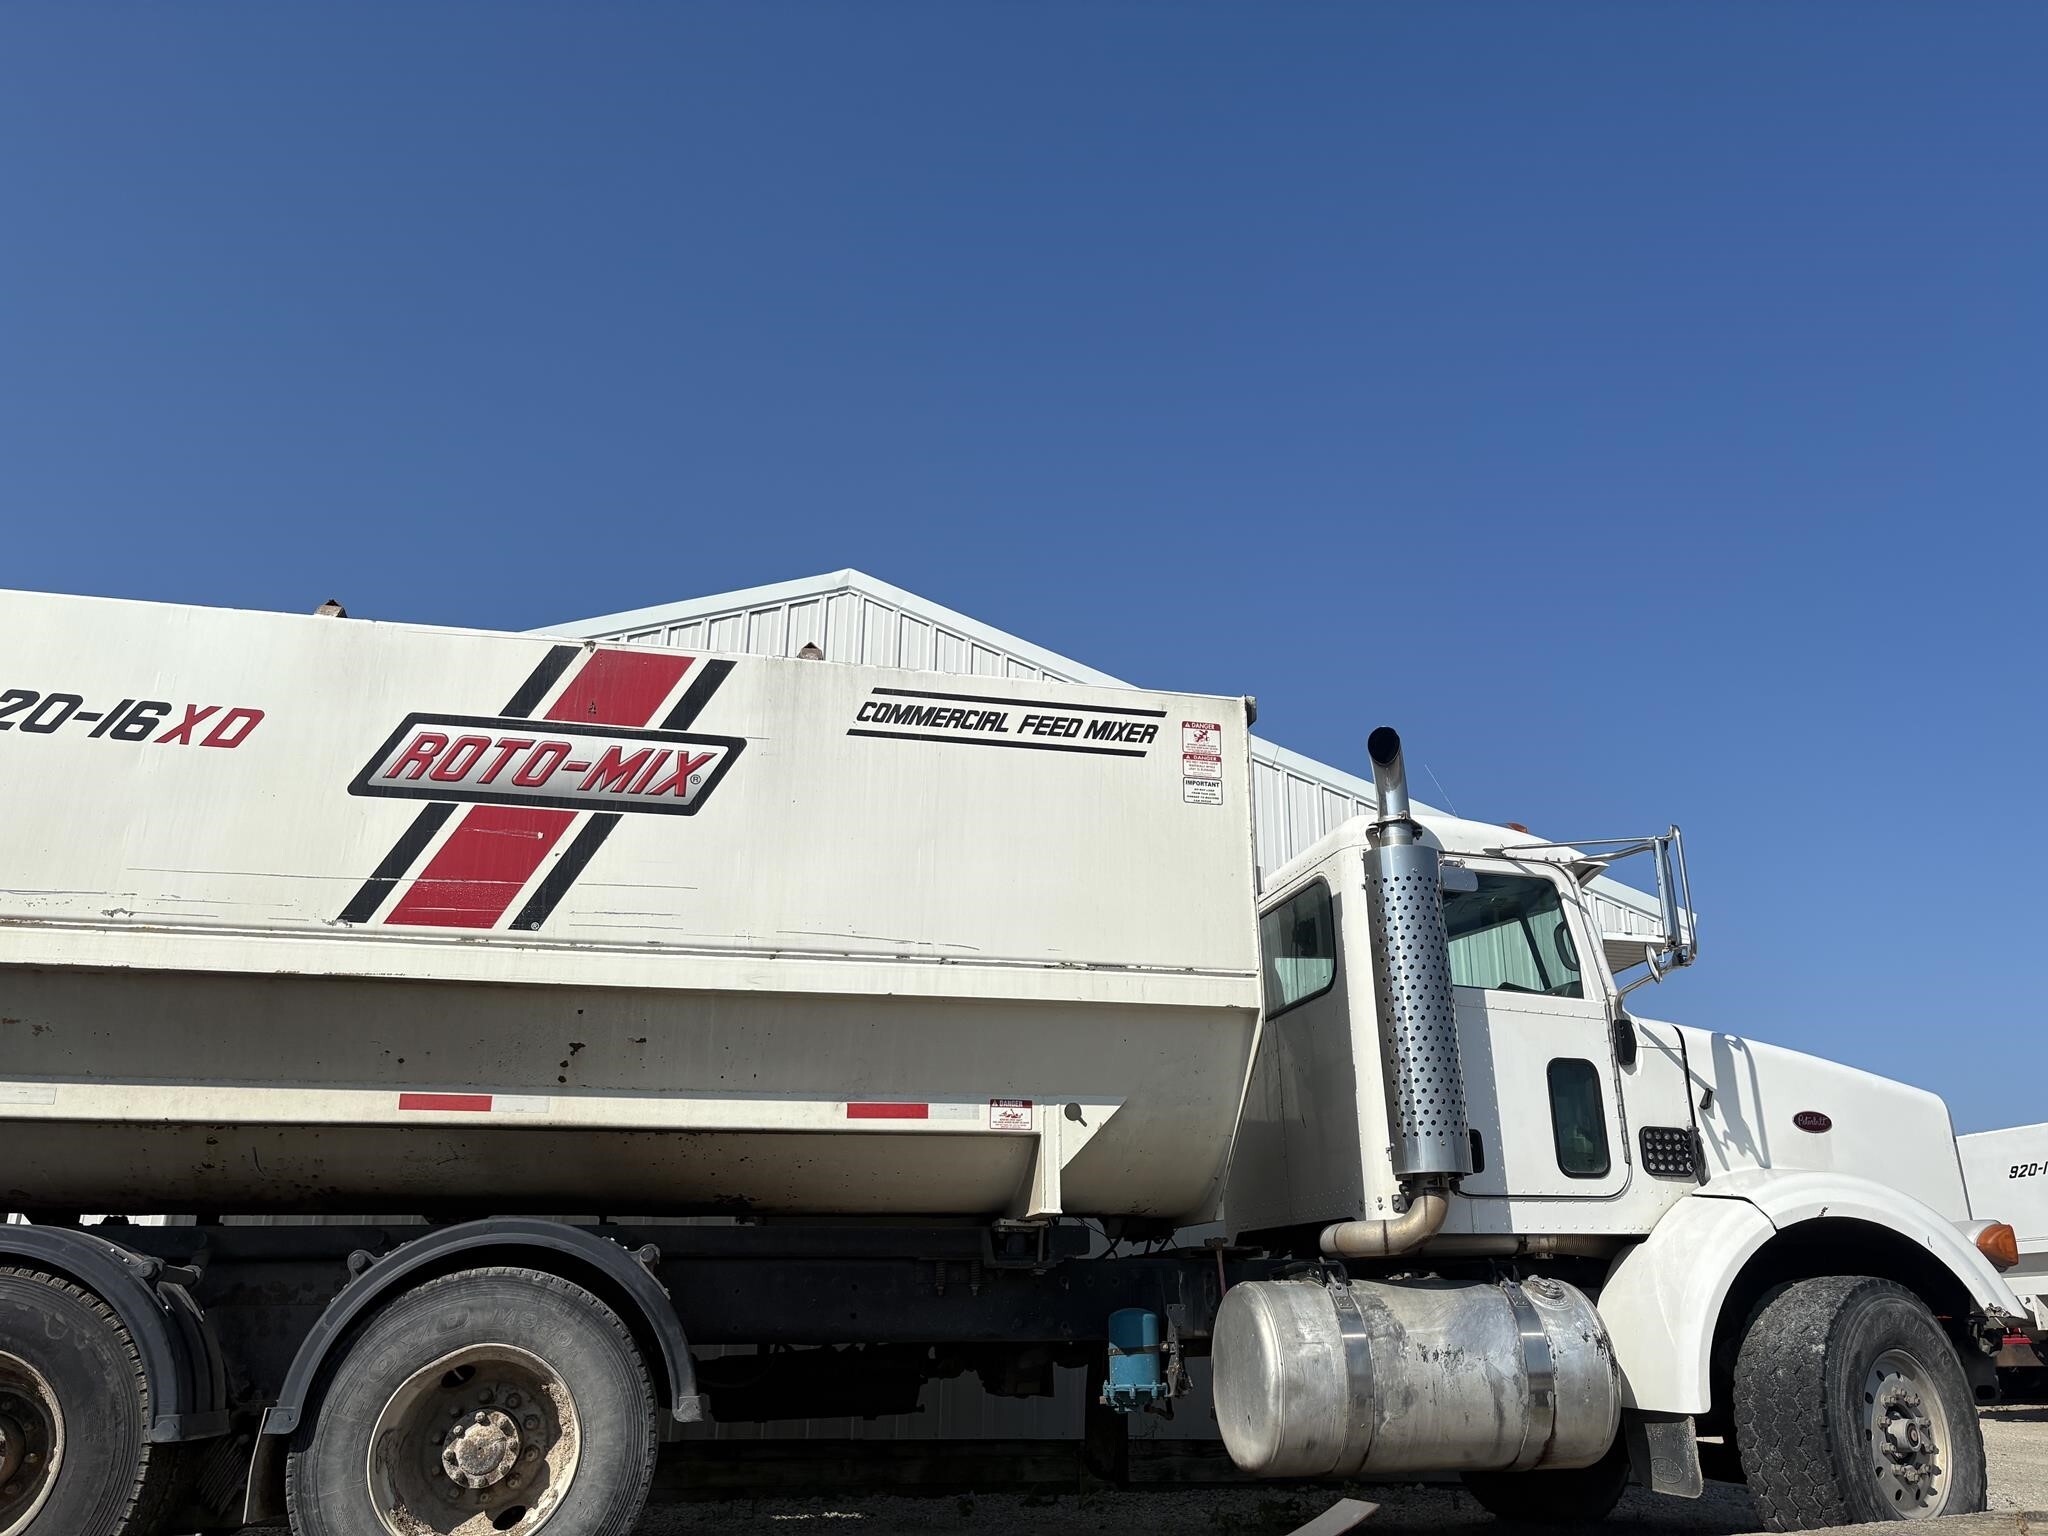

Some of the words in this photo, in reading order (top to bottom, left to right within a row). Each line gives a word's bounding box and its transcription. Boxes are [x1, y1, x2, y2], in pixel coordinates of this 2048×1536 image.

[856, 701, 1009, 733] COMMERCIAL
[1017, 714, 1084, 738] FEED
[1083, 719, 1159, 744] MIXER
[1191, 722, 1215, 730] DANGER
[1185, 779, 1220, 788] IMPORTANT
[999, 1100, 1023, 1108] DANGER
